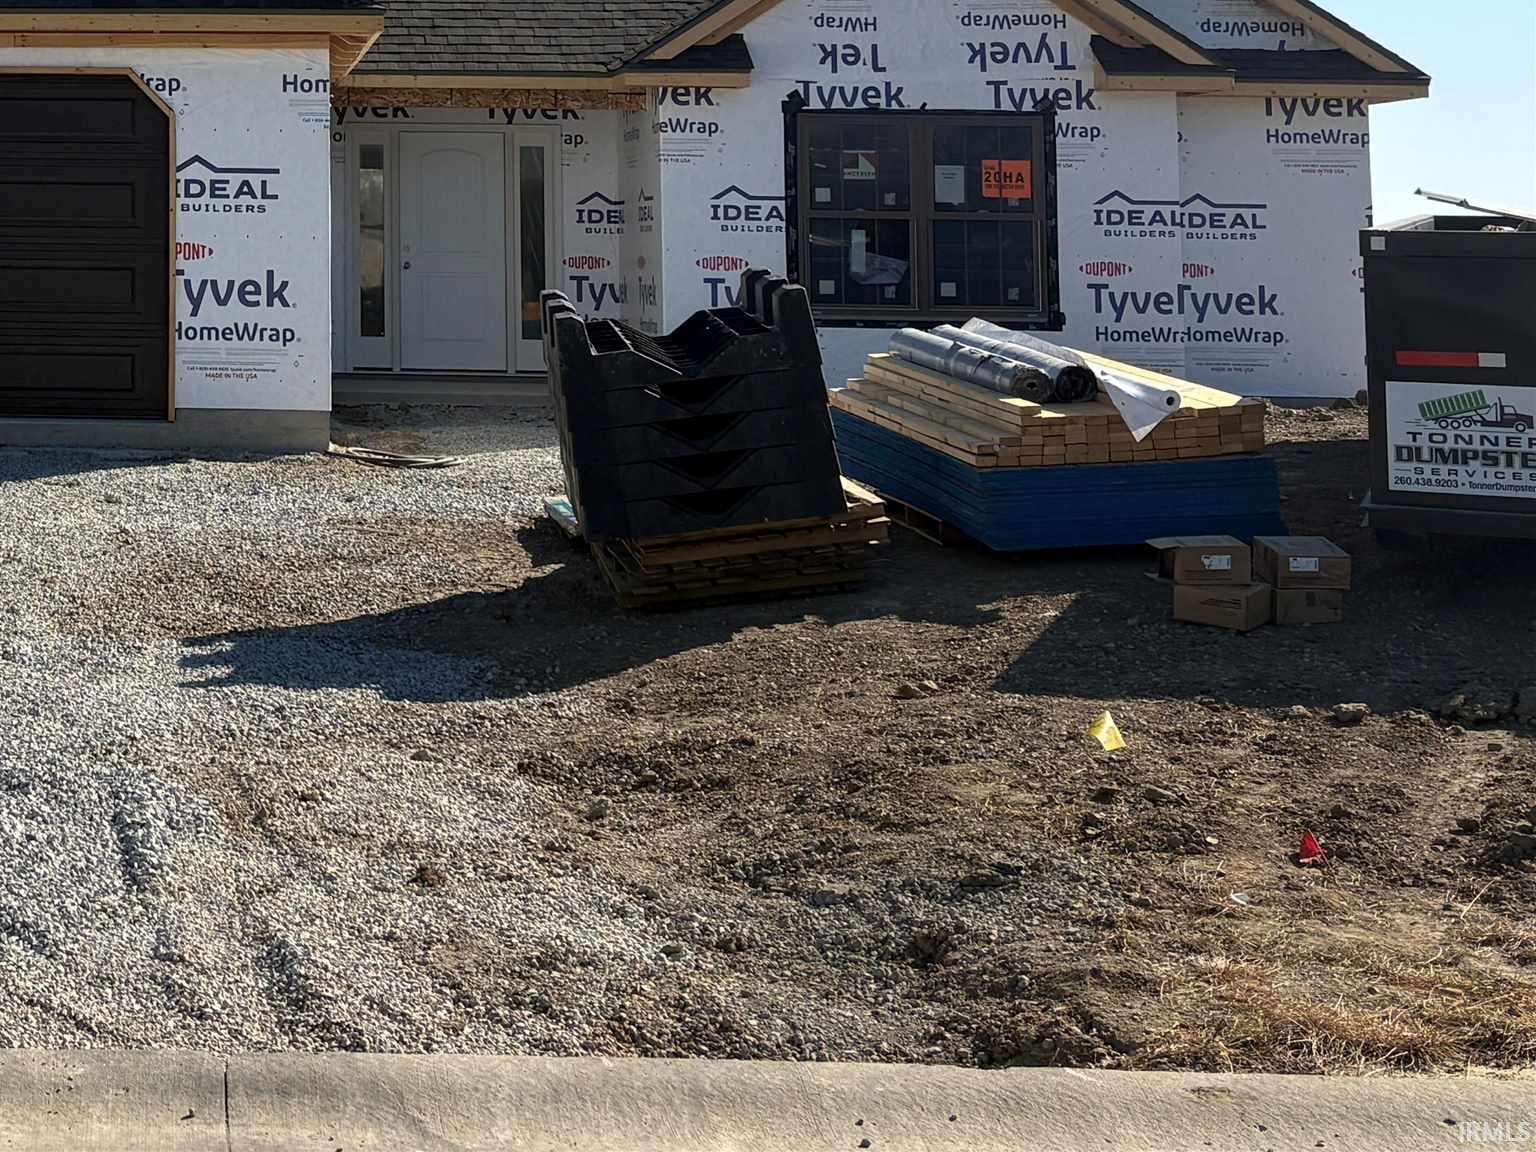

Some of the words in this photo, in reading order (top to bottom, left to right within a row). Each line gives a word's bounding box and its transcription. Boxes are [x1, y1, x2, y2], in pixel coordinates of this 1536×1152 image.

[961, 14, 1066, 30] HomeWrap
[968, 33, 1076, 72] Tyvek
[181, 204, 266, 213] BUILDERS
[1093, 210, 1180, 226] IDEAL
[1180, 212, 1266, 229] IDEAL
[1104, 229, 1176, 238] BUILDERS
[1186, 232, 1257, 240] BUILDERS
[569, 256, 606, 269] DUPONT
[702, 256, 743, 271] DUPONT
[1085, 261, 1126, 277] DUPONT
[175, 269, 291, 317] yvek
[1184, 285, 1279, 323] yvek
[1394, 475, 1459, 489] 260.438.9203
